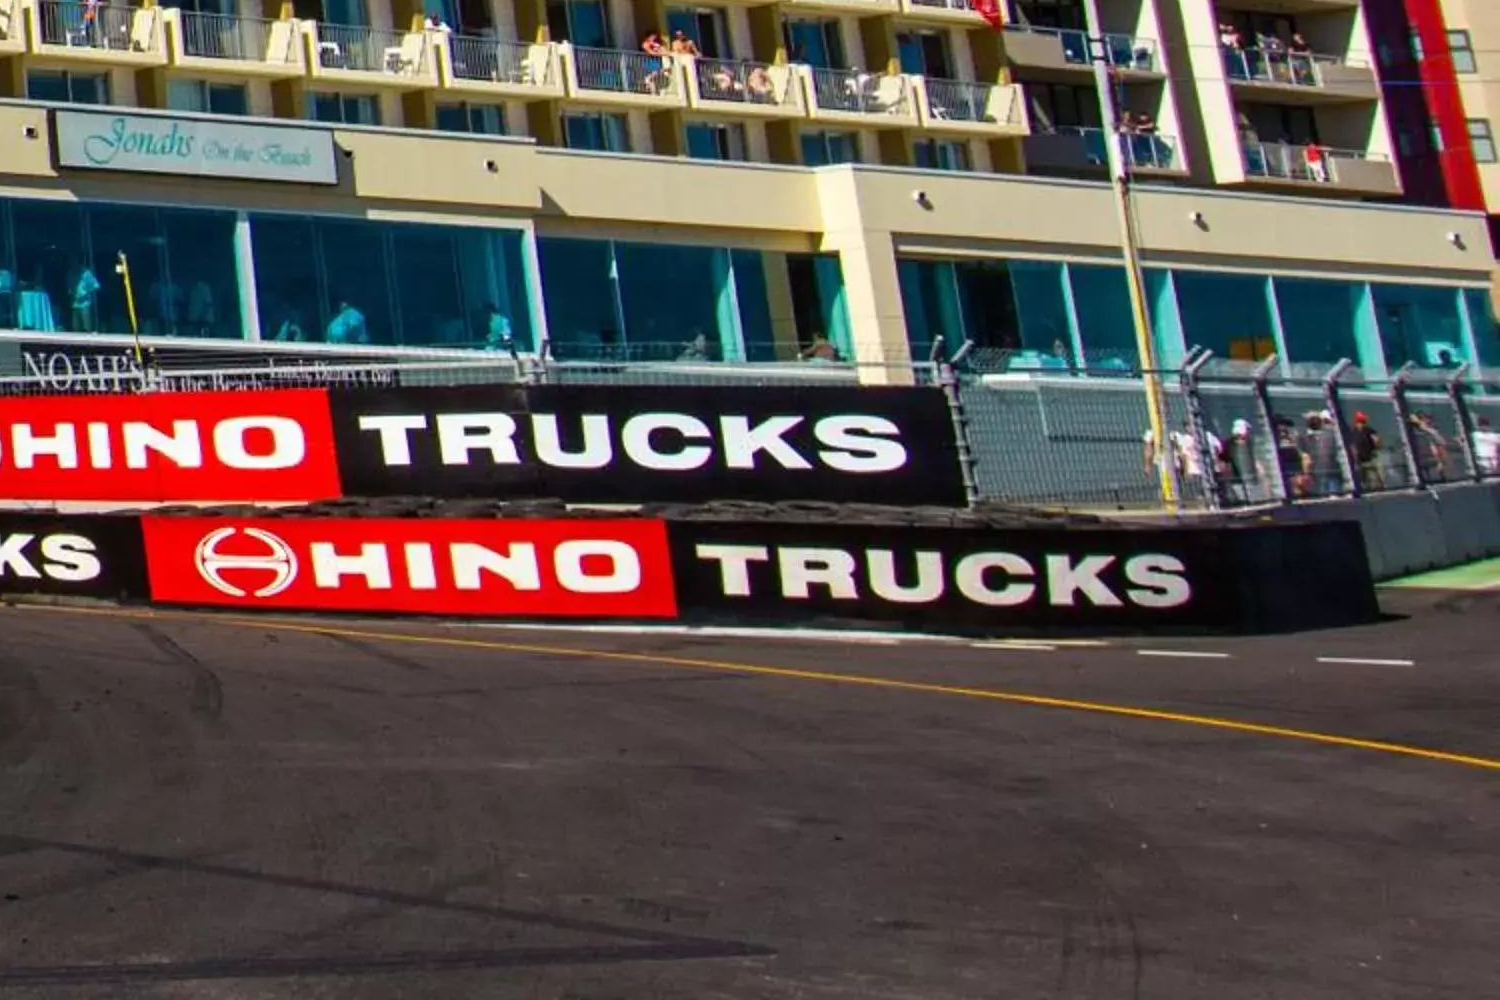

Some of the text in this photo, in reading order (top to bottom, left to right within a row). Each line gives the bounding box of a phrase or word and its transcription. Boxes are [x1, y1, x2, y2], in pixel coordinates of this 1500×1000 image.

[257, 143, 312, 168] Beach
[11, 412, 908, 474] HINO TRUCKS
[310, 539, 1193, 609] HINO TRUCKS
